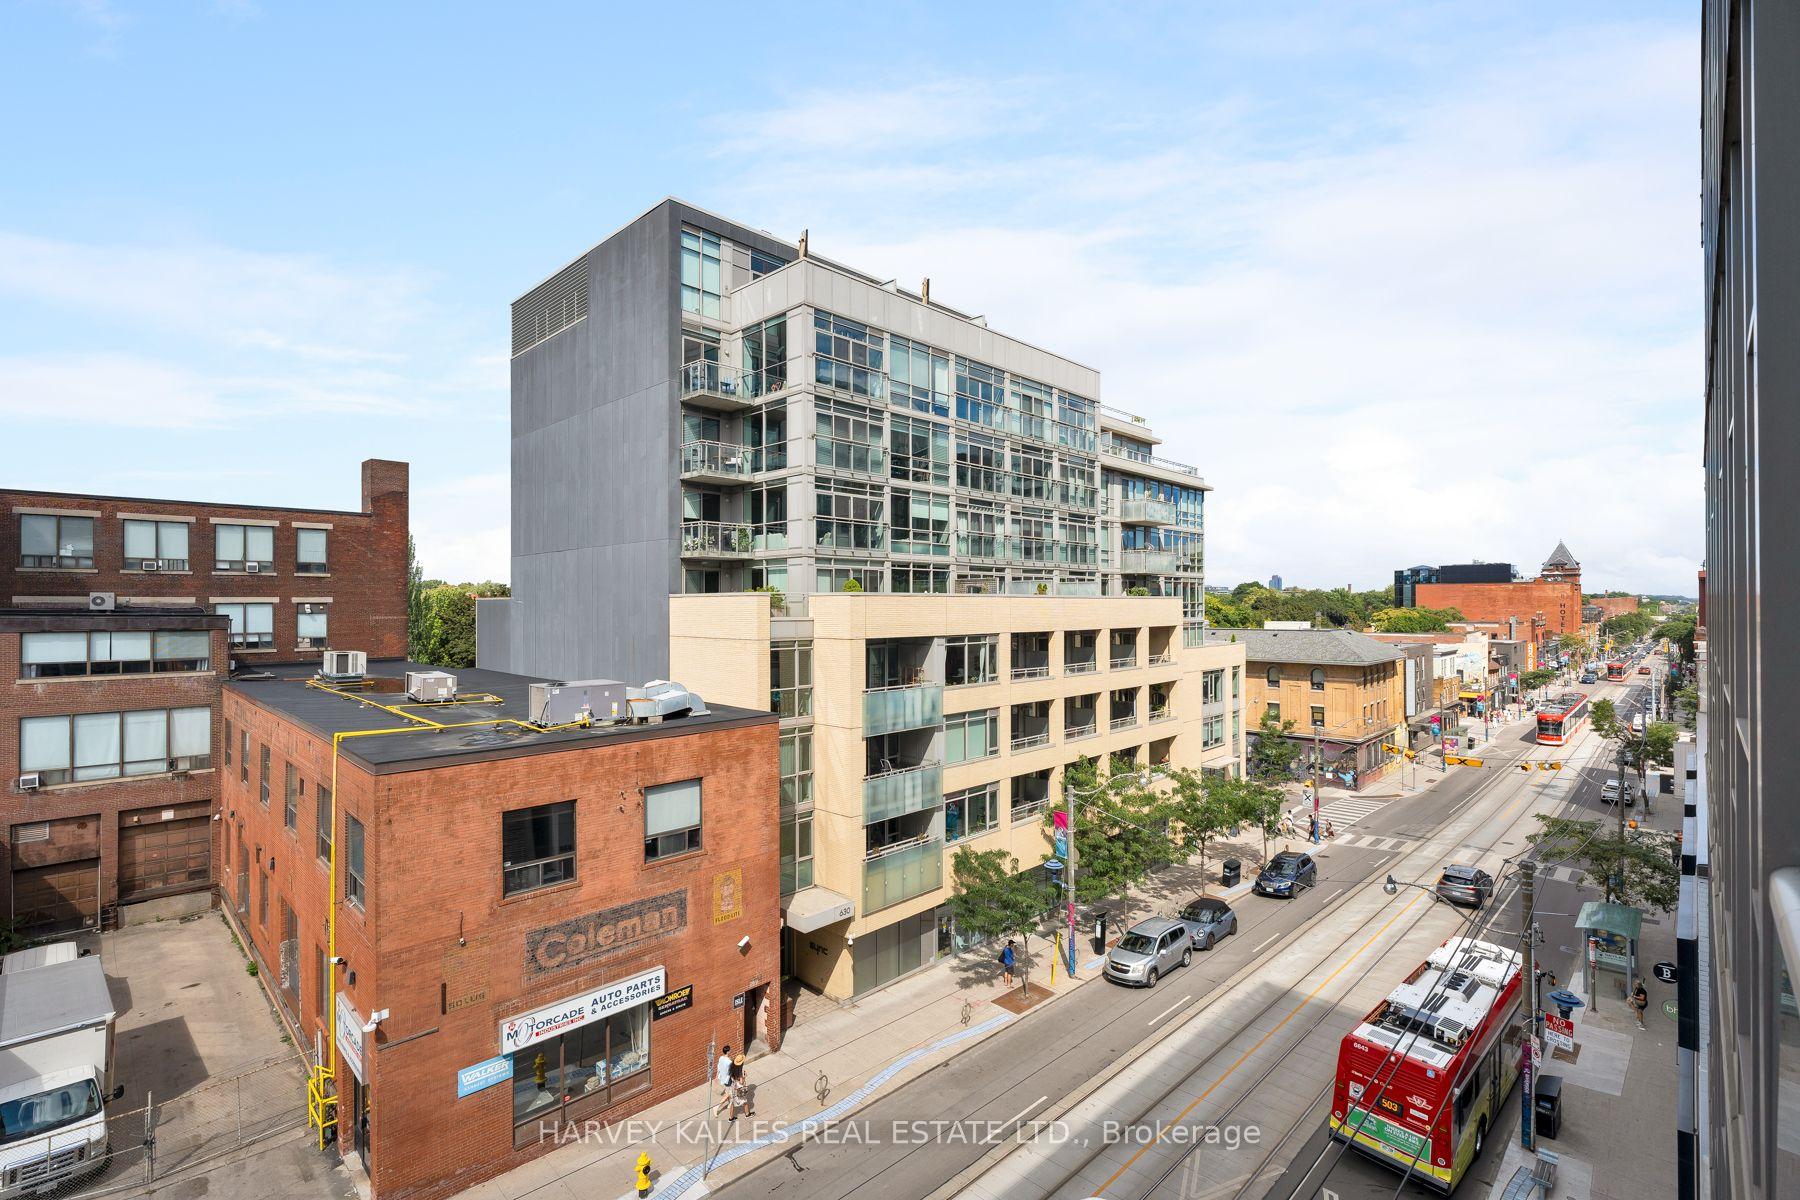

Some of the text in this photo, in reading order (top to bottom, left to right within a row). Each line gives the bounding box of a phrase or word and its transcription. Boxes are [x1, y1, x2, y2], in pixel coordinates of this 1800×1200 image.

[839, 907, 850, 917] 630
[536, 905, 677, 968] Coleman
[1663, 968, 1671, 978] B
[591, 975, 661, 1007] AUTO PARTS
[600, 985, 661, 1011] ACCESSORIES
[507, 1006, 584, 1047] MOTORCADE
[539, 1019, 572, 1036] INDUSTRIES
[1545, 1021, 1573, 1037] PASSING
[1553, 1017, 1566, 1027] NO
[462, 1060, 510, 1084] WALKER
[1382, 1099, 1398, 1111] 503
